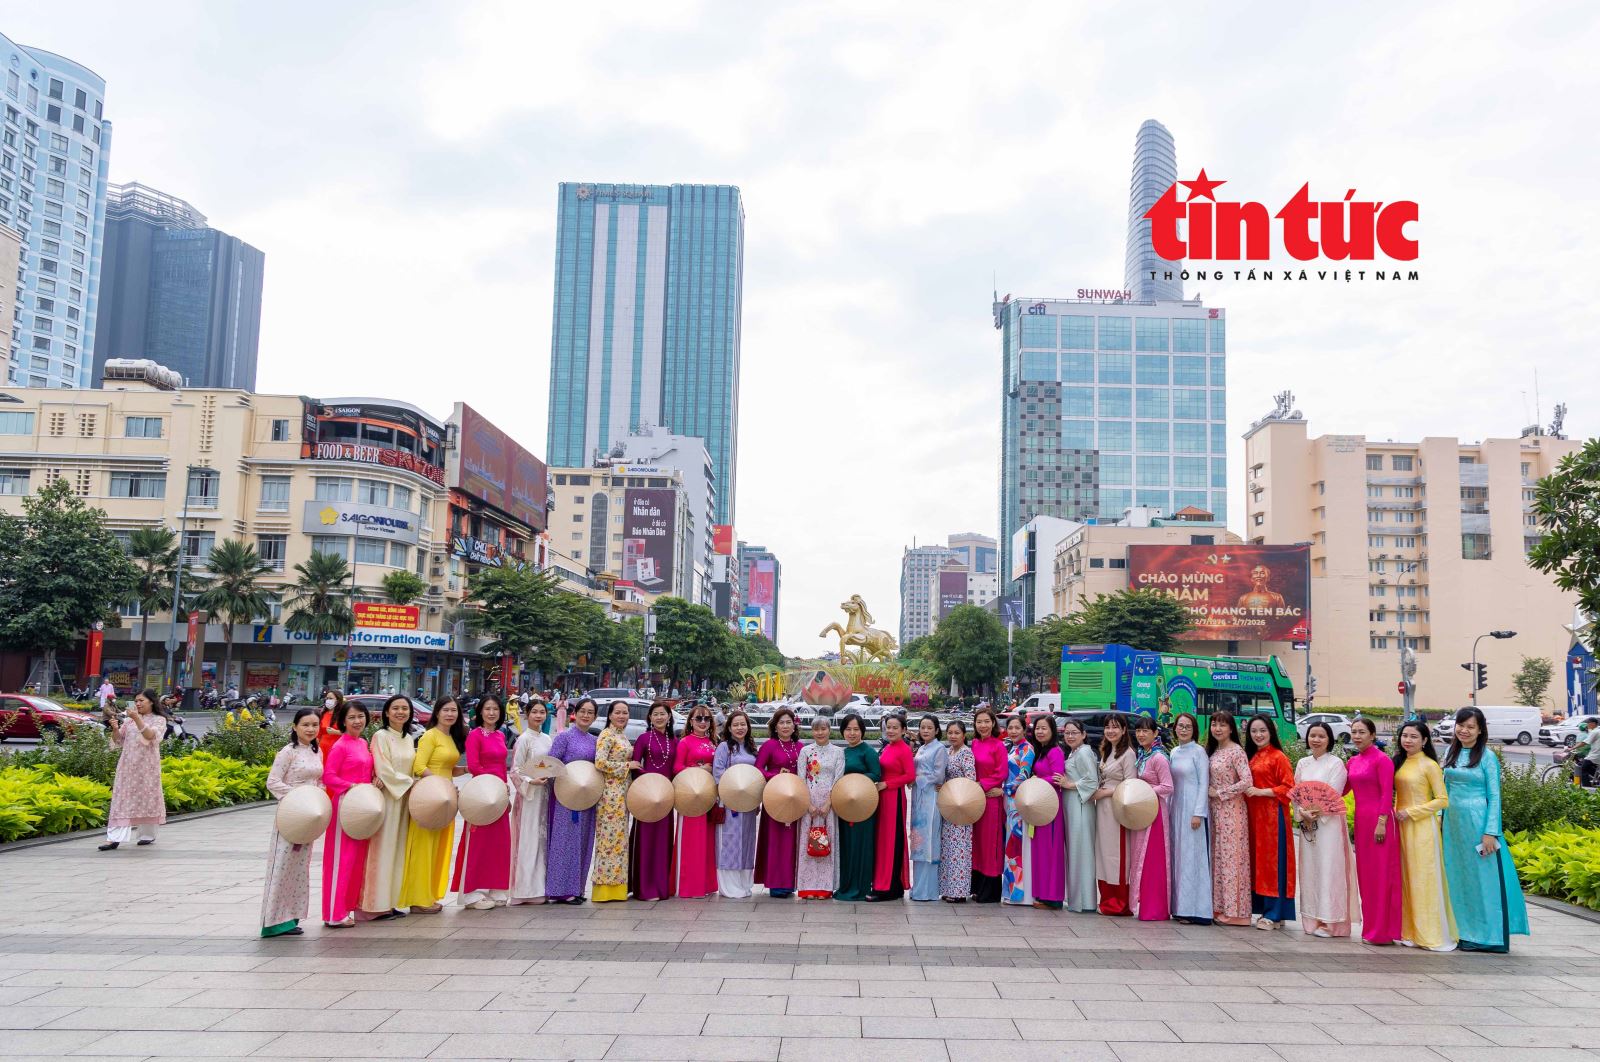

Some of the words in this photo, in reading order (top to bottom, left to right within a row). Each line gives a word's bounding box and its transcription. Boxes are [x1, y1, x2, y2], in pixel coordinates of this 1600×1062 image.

[1077, 288, 1132, 300] SUNWAH
[1028, 303, 1046, 316] citi
[317, 443, 343, 459] FOOD
[344, 448, 351, 458] &
[353, 445, 380, 463] BEER
[633, 506, 648, 516] Nhân
[341, 513, 409, 530] SAIGONTOURIST
[632, 526, 642, 536] Báo
[642, 526, 656, 536] Nhân
[656, 527, 666, 536] Dân
[1138, 570, 1178, 584] CHÀO
[1182, 570, 1224, 584] MỪNG
[1166, 585, 1209, 601] NĂM
[1211, 607, 1247, 616] MANG
[1249, 605, 1273, 616] TÊN
[1275, 604, 1301, 616] BÁC
[1232, 618, 1266, 627] 2/7/2026
[424, 635, 447, 647] Center
